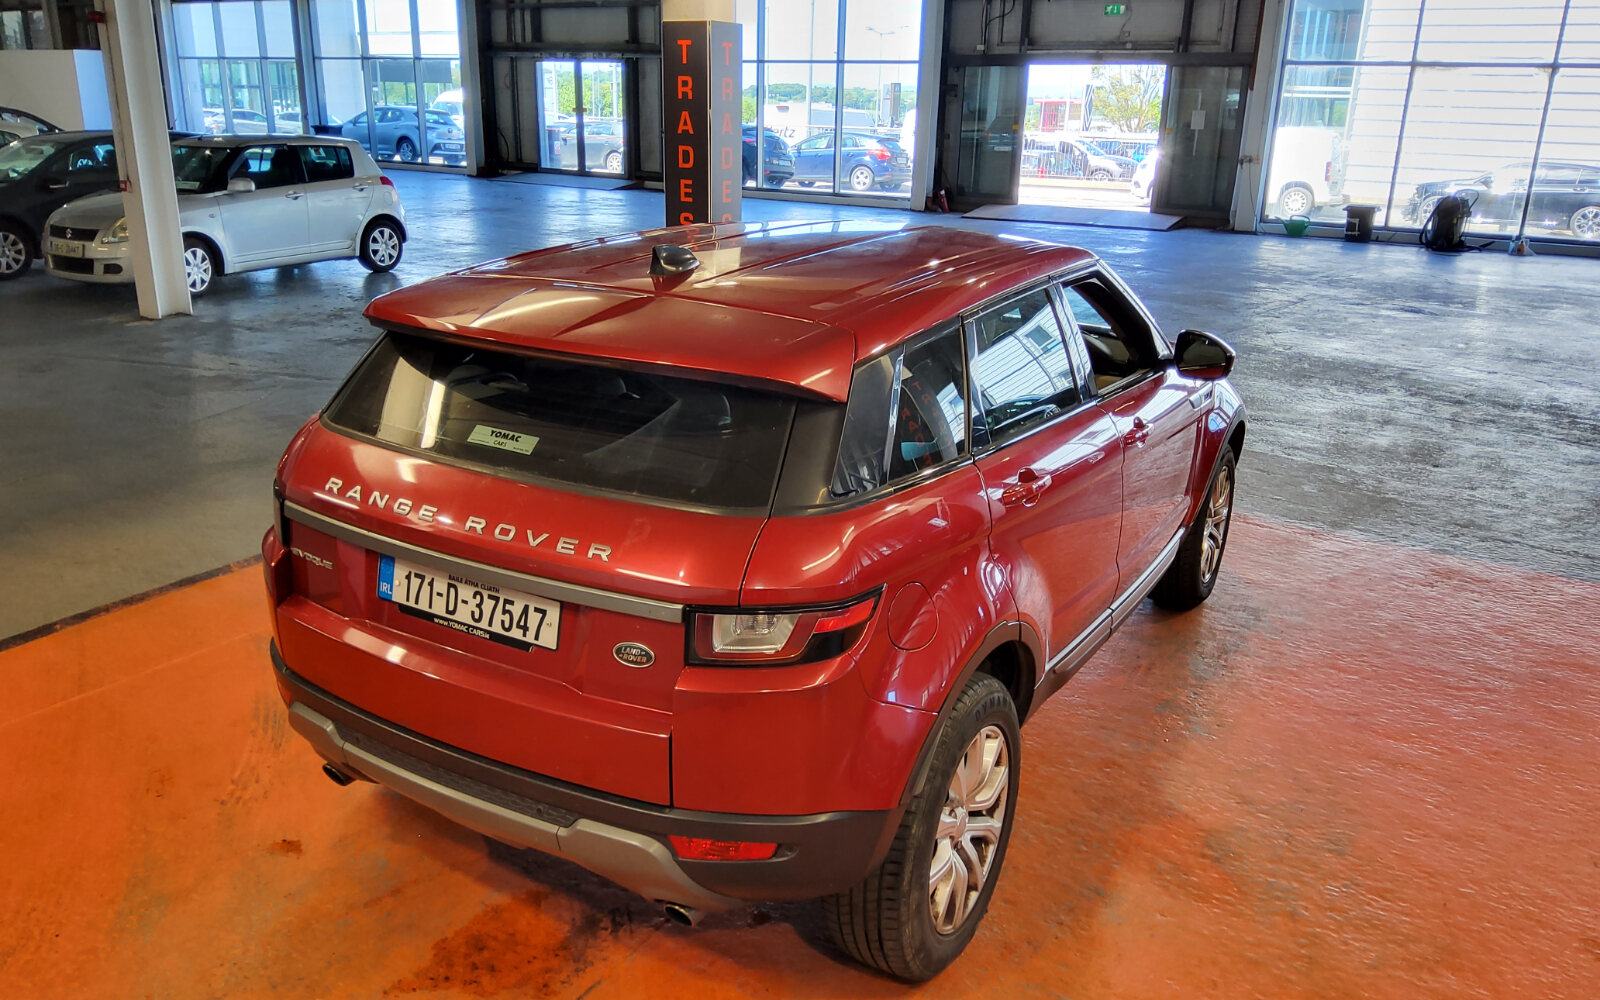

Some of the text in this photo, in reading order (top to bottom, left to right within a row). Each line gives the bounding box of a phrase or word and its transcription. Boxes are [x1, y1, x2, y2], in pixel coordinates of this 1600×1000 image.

[490, 429, 522, 442] YOMAC
[325, 477, 612, 562] RANGE ROVER
[380, 581, 392, 595] IRL
[480, 583, 500, 594] CLIATH
[405, 570, 547, 641] 171-D-37547
[621, 647, 641, 656] LAND
[622, 653, 647, 663] ROVER
